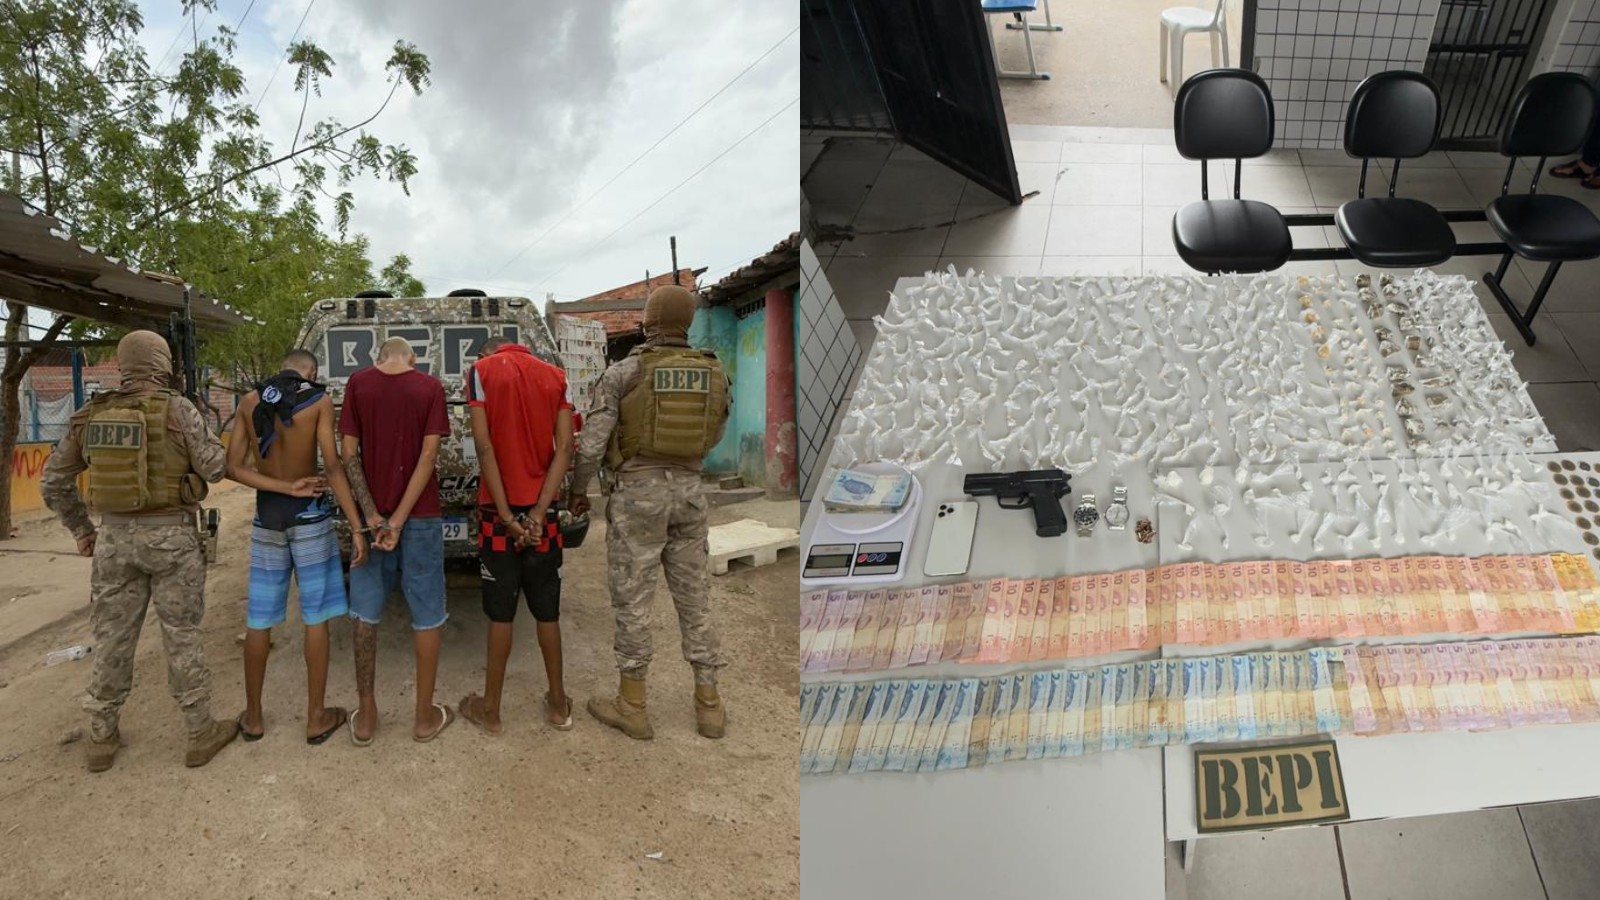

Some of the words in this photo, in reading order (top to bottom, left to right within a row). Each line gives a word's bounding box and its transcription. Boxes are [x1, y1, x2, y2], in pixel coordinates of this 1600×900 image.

[657, 370, 709, 390] BEPI
[88, 424, 140, 446] BEPI
[443, 524, 460, 538] 29
[1260, 563, 1270, 574] 10
[1277, 563, 1286, 573] 10
[1293, 563, 1302, 574] 10
[1354, 562, 1362, 572] 10
[1373, 561, 1381, 572] 10
[1390, 563, 1399, 573] 10
[1418, 560, 1426, 569] 10
[1431, 560, 1440, 570] 10
[1483, 559, 1494, 569] 10
[1499, 559, 1509, 569] 10
[1516, 558, 1526, 568] 10
[1162, 568, 1171, 580] 10
[1175, 567, 1185, 577] 10
[1190, 565, 1200, 576] 10
[1232, 566, 1241, 577] 10
[1308, 566, 1317, 577] 10
[1114, 574, 1123, 585] 10
[1130, 573, 1140, 584] 10
[1146, 571, 1155, 583] 10
[992, 581, 1001, 592] 10
[1007, 583, 1017, 594] 10
[1025, 581, 1035, 592] 10
[1040, 583, 1049, 593] 10
[1057, 579, 1065, 590] 10
[1072, 581, 1081, 591] 10
[1087, 578, 1096, 589] 10
[1201, 751, 1341, 820] BEPI
